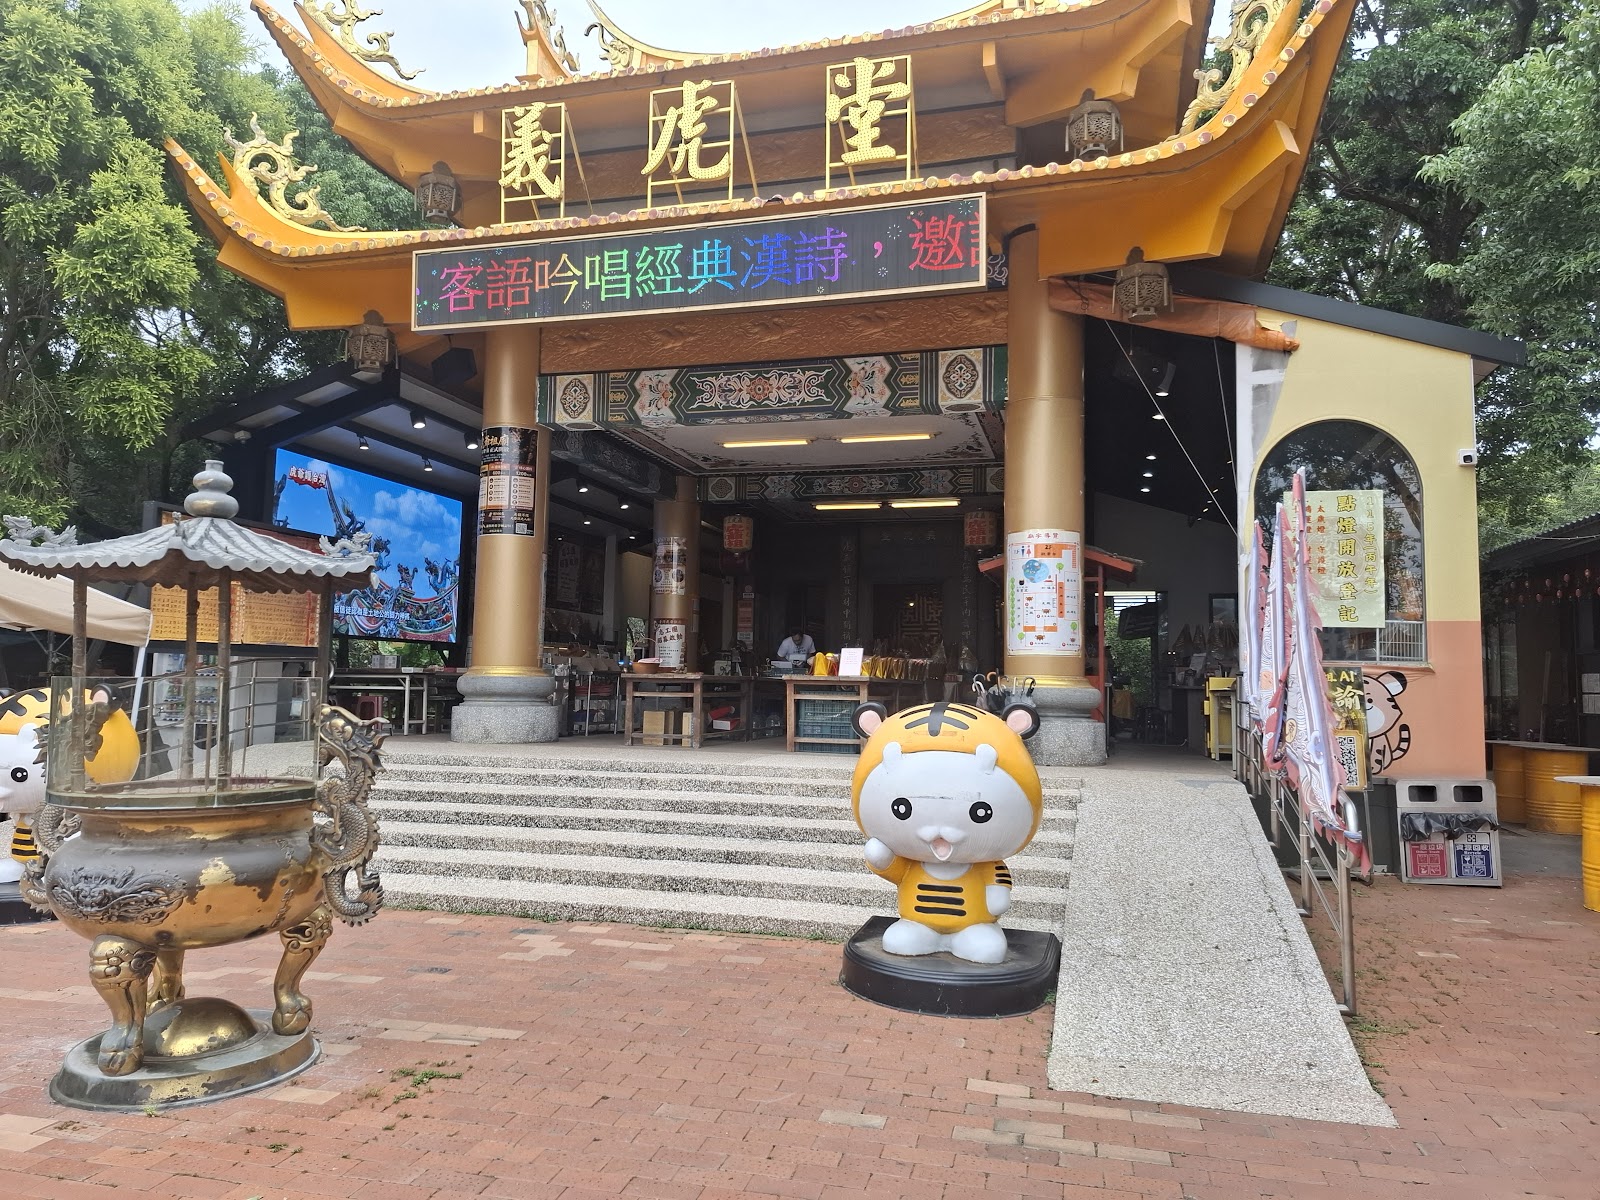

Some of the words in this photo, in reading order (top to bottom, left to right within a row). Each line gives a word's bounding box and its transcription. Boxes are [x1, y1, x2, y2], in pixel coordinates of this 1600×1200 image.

[498, 57, 912, 200] 義虎堂
[1336, 495, 1359, 622] 點燈開放登記
